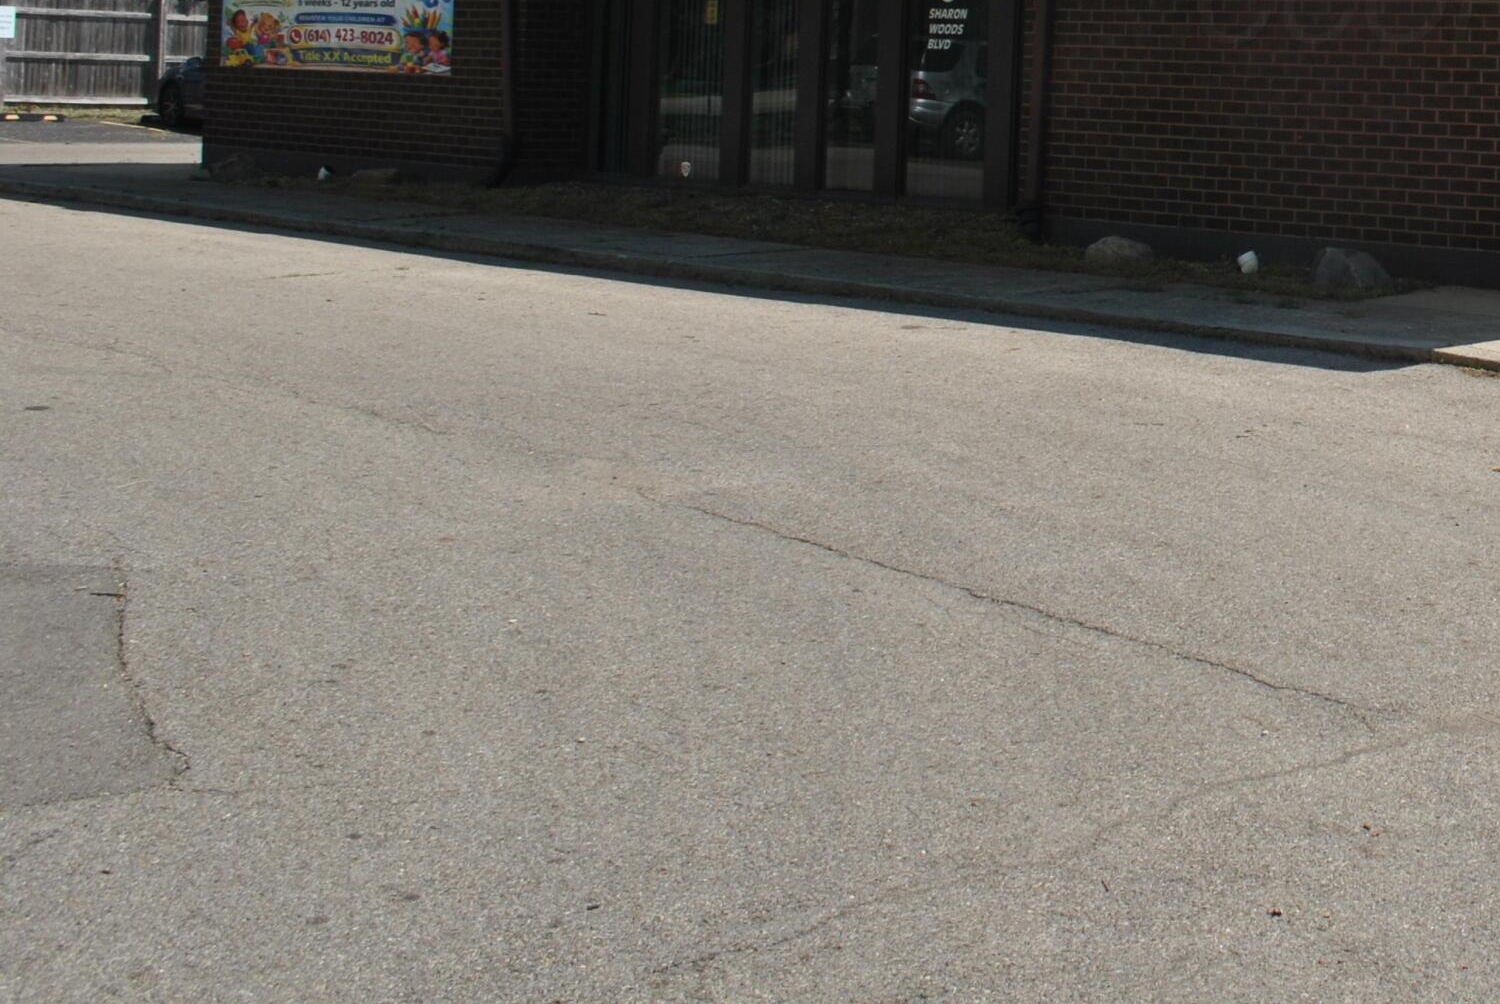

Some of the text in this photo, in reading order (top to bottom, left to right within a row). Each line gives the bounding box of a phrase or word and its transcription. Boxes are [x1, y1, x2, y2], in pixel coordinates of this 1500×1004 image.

[352, 0, 378, 10] years
[928, 8, 968, 20] SHARON
[928, 23, 964, 35] WOODS
[304, 28, 394, 45] (614) 423-8024
[927, 38, 951, 50] BLVD
[299, 50, 392, 65] Title XX Accepted
